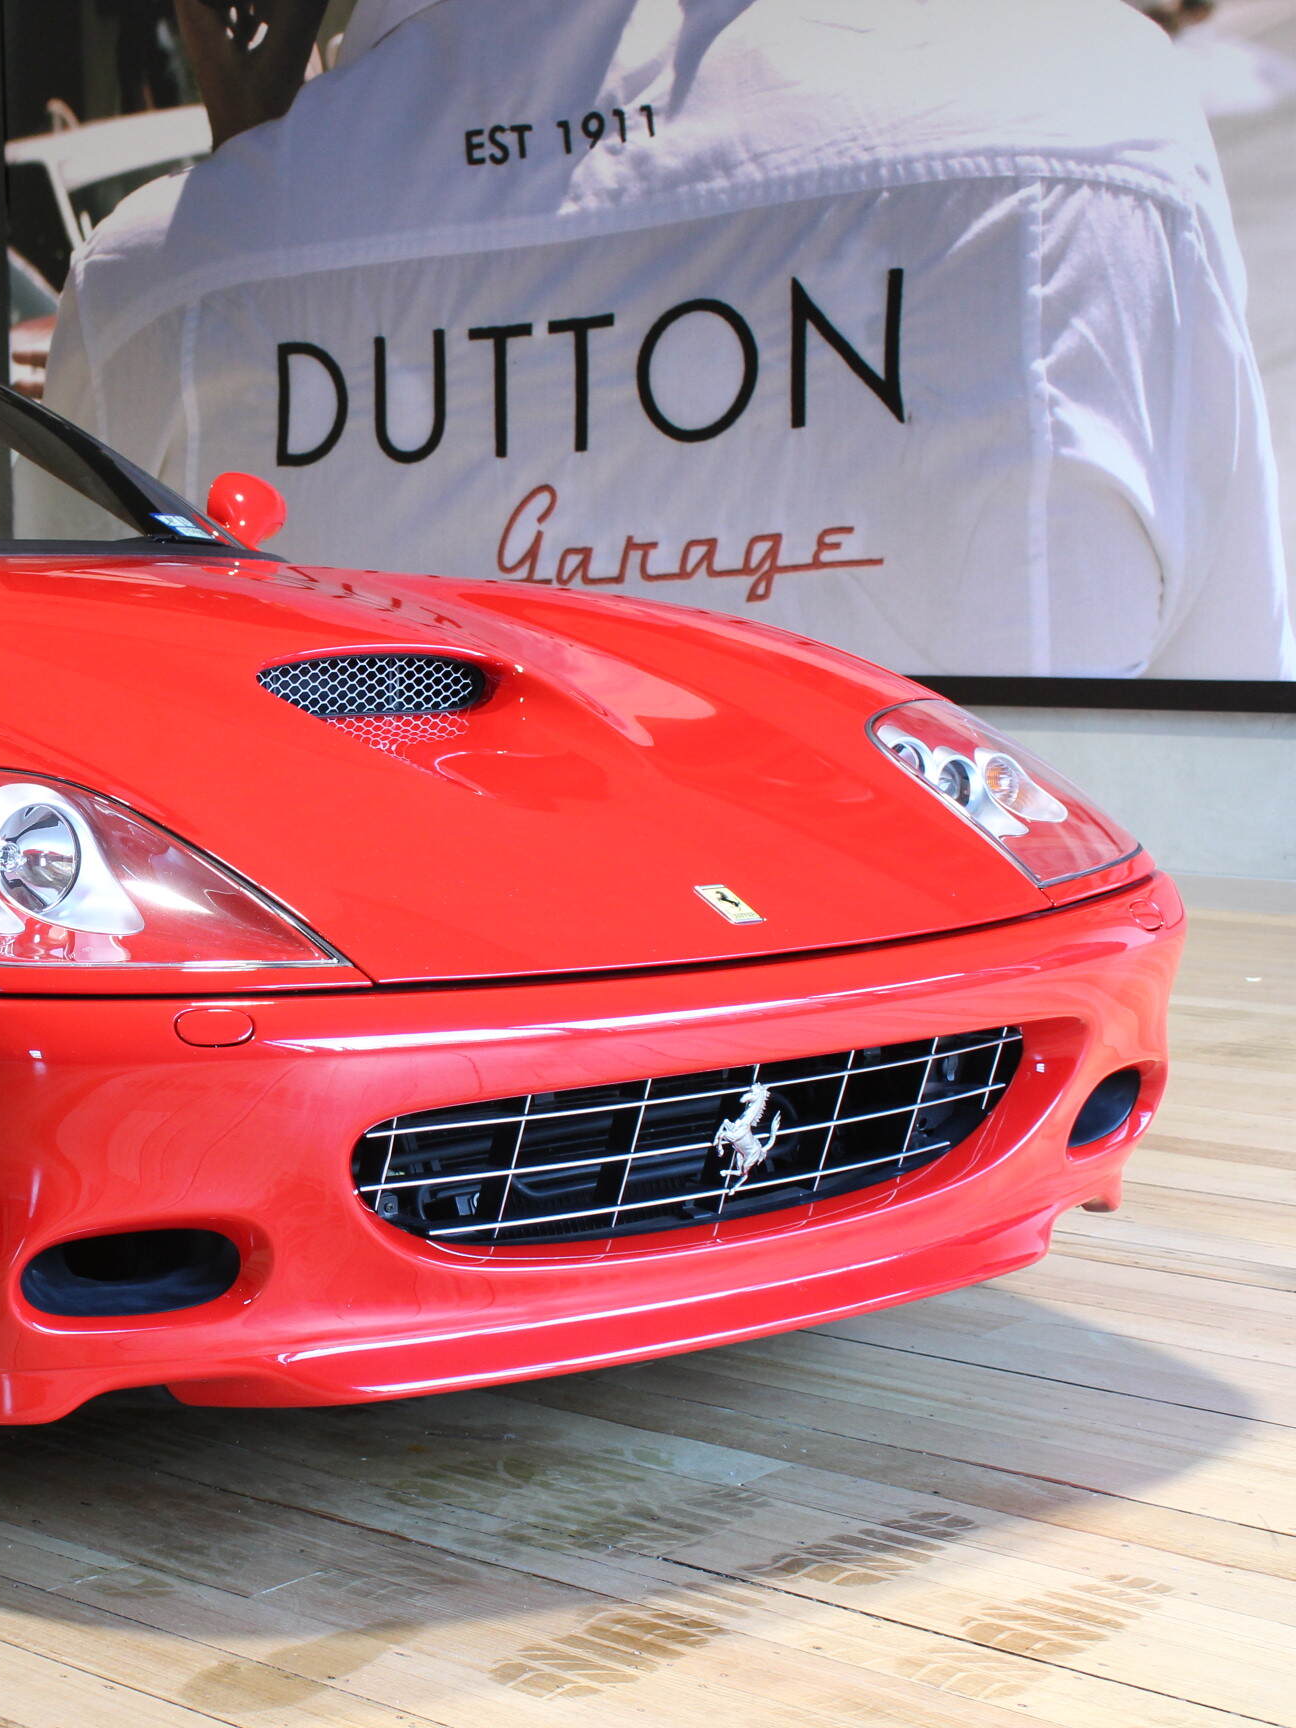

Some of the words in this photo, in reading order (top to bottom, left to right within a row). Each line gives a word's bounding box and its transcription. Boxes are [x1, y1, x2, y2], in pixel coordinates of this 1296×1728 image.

[464, 123, 533, 165] EST
[556, 104, 655, 154] 1911
[276, 267, 906, 467] DUTTON
[497, 483, 884, 603] Garage
